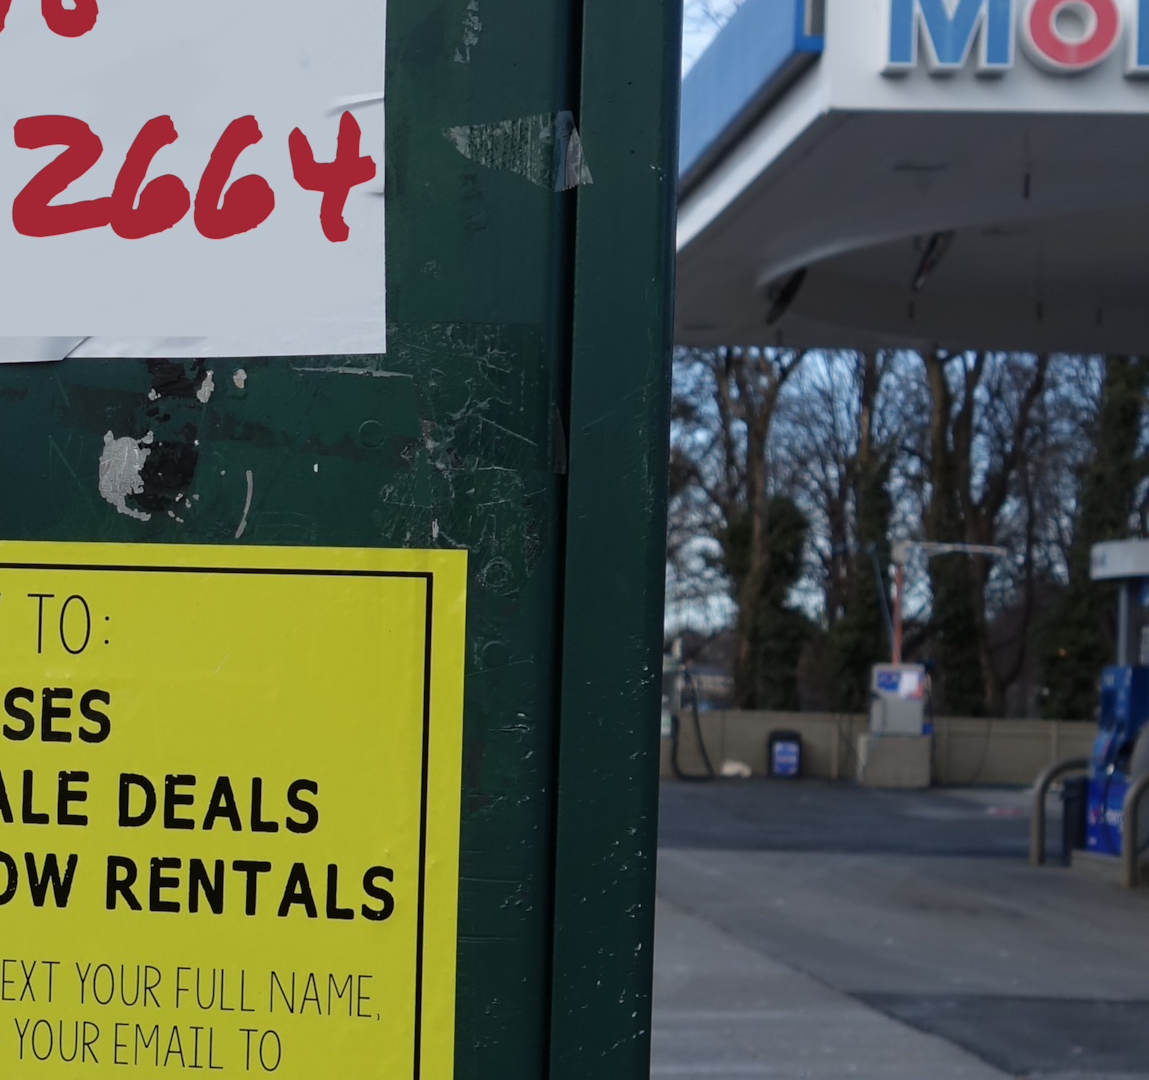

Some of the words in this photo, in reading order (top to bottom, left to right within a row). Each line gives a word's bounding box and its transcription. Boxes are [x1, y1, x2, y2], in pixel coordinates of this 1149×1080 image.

[28, 594, 112, 655] TO:
[117, 773, 320, 834] DEALS
[106, 856, 396, 921] RENTALS
[75, 962, 162, 1008] YOUR
[175, 967, 256, 1014] FULL
[268, 971, 382, 1022] NAME,
[14, 1018, 100, 1063] YOUR
[113, 1023, 224, 1070] EMAIL
[238, 1029, 283, 1072] TO
